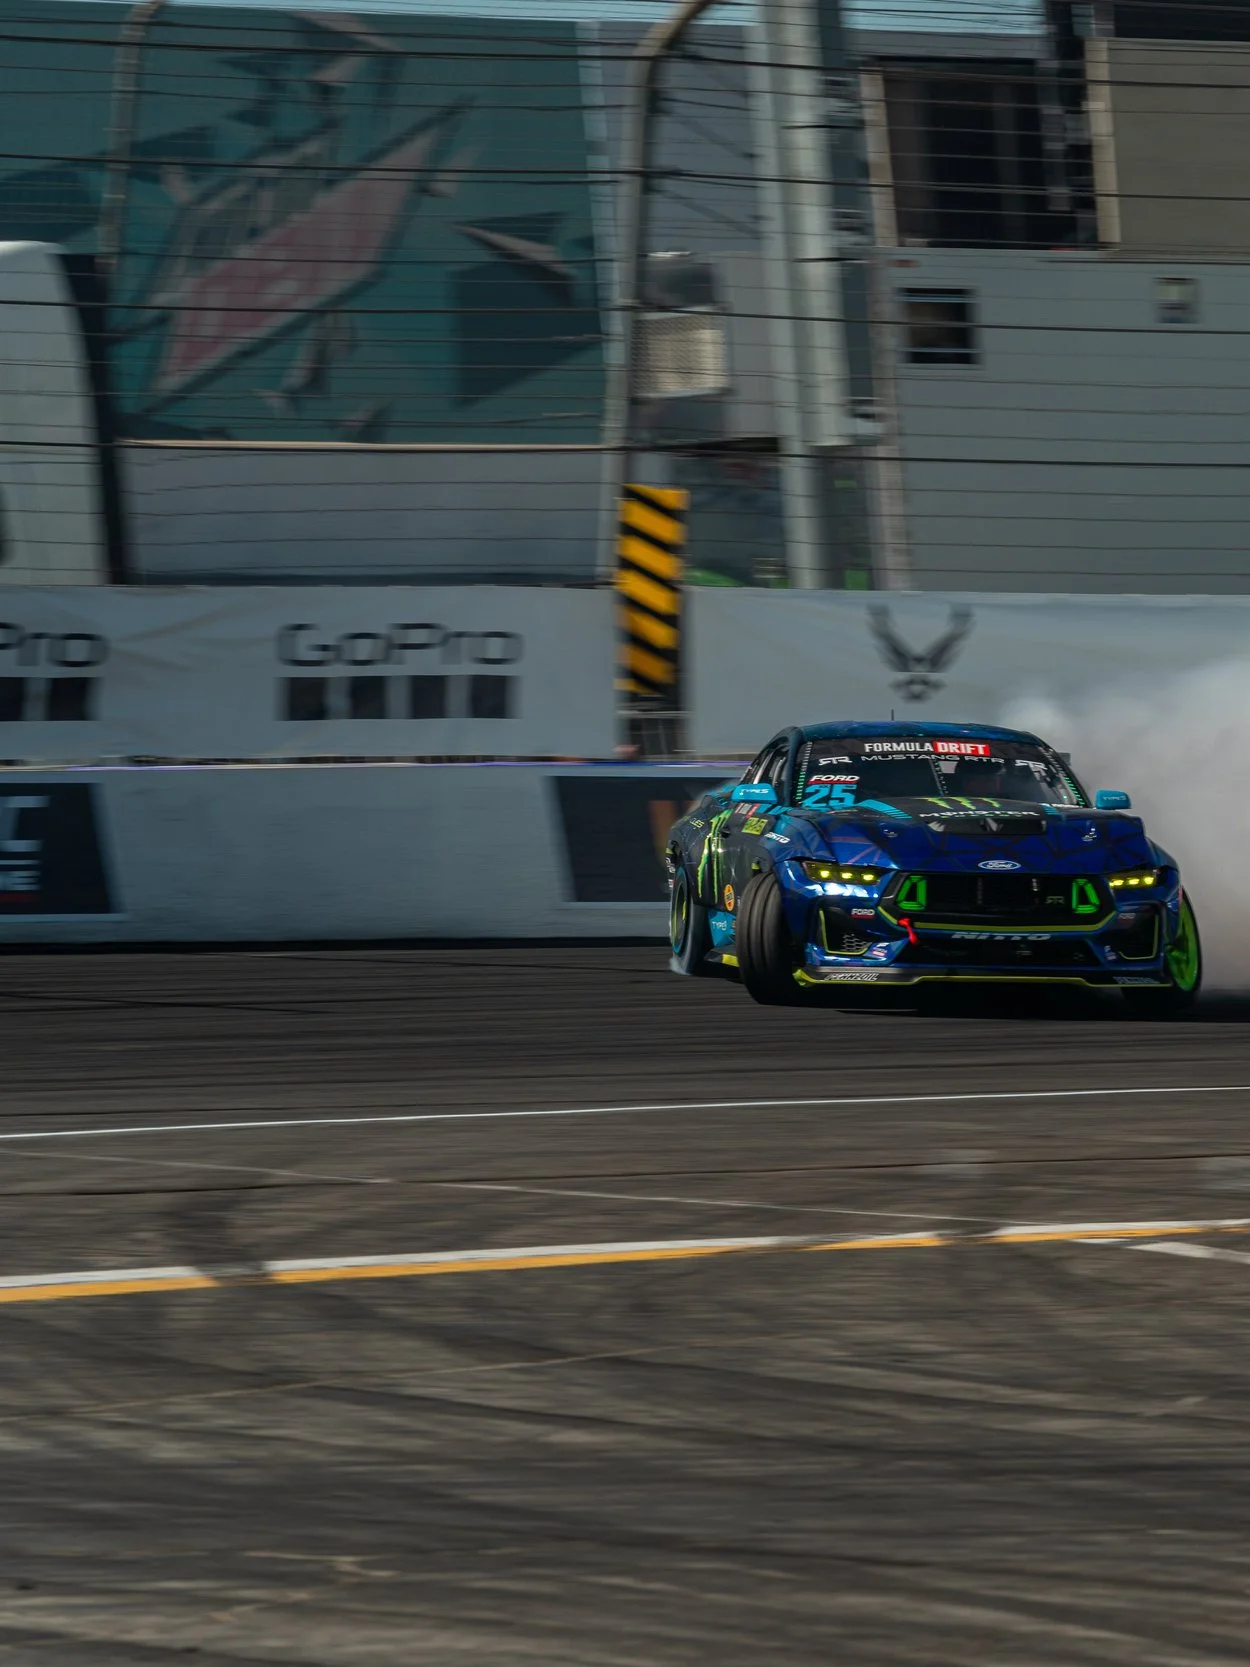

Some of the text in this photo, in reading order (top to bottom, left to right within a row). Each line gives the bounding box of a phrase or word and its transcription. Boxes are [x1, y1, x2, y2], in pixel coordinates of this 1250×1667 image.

[276, 623, 524, 667] GoPro
[864, 743, 987, 755] FORMULA DRIFT
[861, 754, 1005, 764] MUSTANG RTR
[810, 774, 860, 782] FORD
[803, 783, 858, 807] 25
[851, 908, 876, 916] FORD
[951, 932, 1051, 941] NITTO
